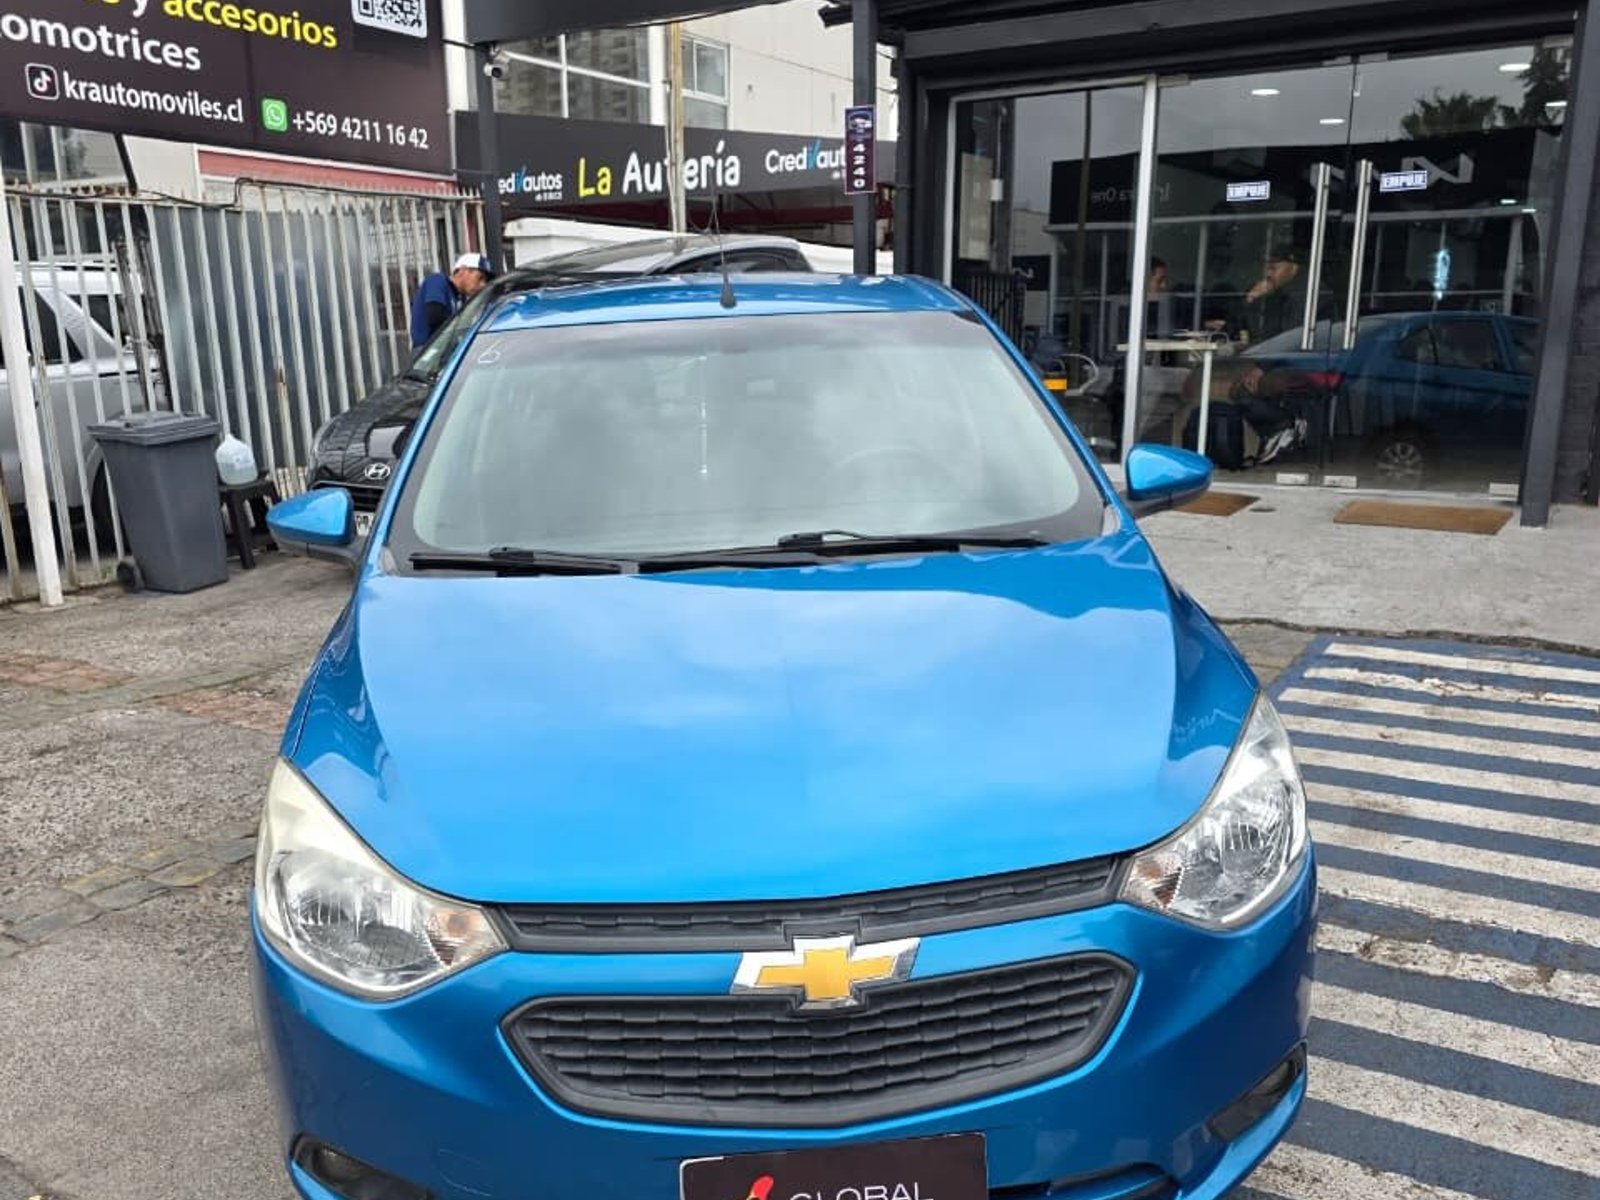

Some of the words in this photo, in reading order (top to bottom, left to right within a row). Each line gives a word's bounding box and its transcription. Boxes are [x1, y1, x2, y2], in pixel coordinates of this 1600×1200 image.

[0, 14, 201, 70] omotrices
[163, 0, 338, 48] accesorios
[63, 70, 244, 123] krautomoviles.cl
[293, 110, 338, 136] +569
[341, 116, 381, 143] 4211
[386, 123, 406, 146] 16
[408, 127, 429, 149] 42
[579, 157, 611, 197] La
[622, 140, 741, 195] Auería
[477, 339, 501, 364] 6
